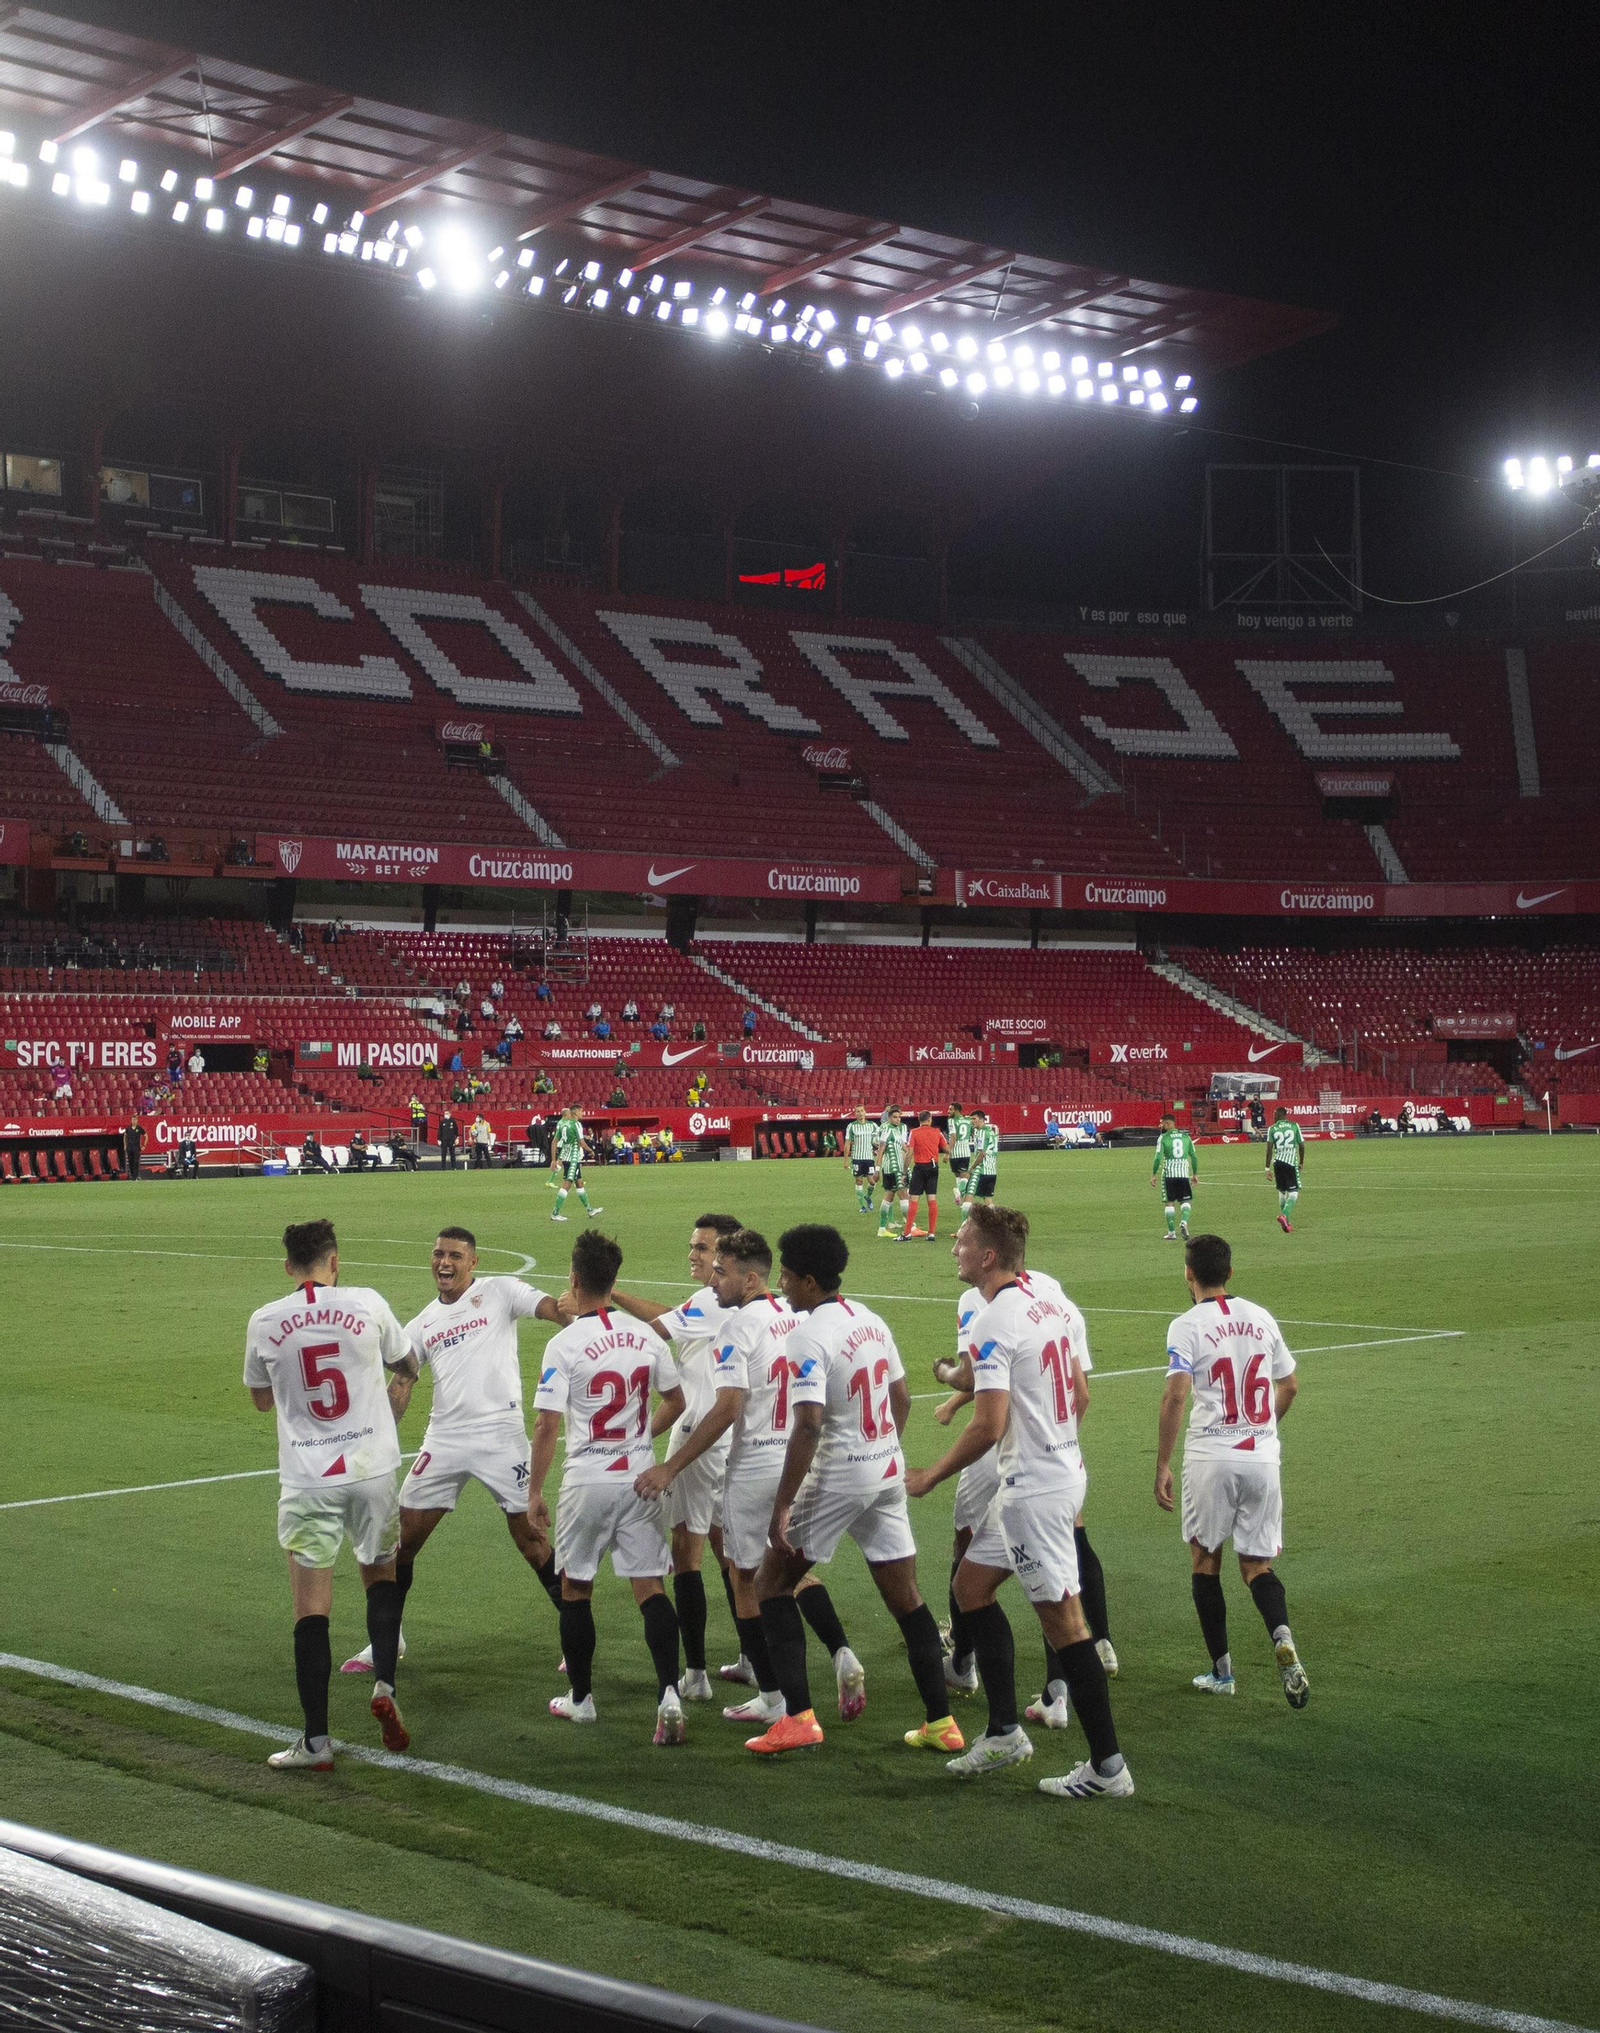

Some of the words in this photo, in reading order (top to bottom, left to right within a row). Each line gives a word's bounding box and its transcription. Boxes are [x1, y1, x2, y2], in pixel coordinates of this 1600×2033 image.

[1079, 606, 1087, 620] Y
[1091, 610, 1105, 621] es
[1109, 611, 1129, 624] por
[1137, 612, 1159, 623] eso
[1163, 613, 1187, 626] que
[1238, 613, 1260, 629] hoy
[1265, 616, 1303, 629] vengo
[1308, 617, 1315, 627] a
[1320, 614, 1353, 627] verte
[336, 843, 439, 863] MARATHON
[374, 864, 401, 875] BET
[469, 853, 573, 884] Cruzcampo
[768, 868, 860, 897] Cruzcampo
[986, 881, 1050, 900] CaixaBank
[1085, 882, 1167, 908] Cruzcampo
[1281, 889, 1374, 912] Cruzcampo
[171, 1015, 216, 1028] MOBILE
[219, 1016, 241, 1028] APP
[1016, 1020, 1046, 1029] SOCIO!
[17, 1041, 60, 1066] SFC
[101, 1042, 157, 1066] ERES
[337, 1043, 361, 1065] MI
[368, 1042, 438, 1066] PASION
[551, 1049, 623, 1058] MARATHONBET
[930, 1050, 976, 1060] CaixaBank
[1129, 1044, 1168, 1059] everfx
[708, 1116, 731, 1131] LaLi
[1044, 1107, 1112, 1126] Cruzcampo
[28, 1128, 64, 1137] Cruzcampo
[155, 1120, 257, 1145] Cruzcampo
[959, 1124, 968, 1140] 9
[1273, 1129, 1296, 1150] 22
[1172, 1138, 1184, 1158] 8
[268, 1309, 366, 1347] L.OCAMPOS
[424, 1317, 488, 1349] MARATHON
[1204, 1321, 1265, 1349] J.NAVAS
[443, 1333, 466, 1348] BET
[584, 1332, 648, 1361] OLIVER.T
[298, 1342, 350, 1421] 5
[1207, 1353, 1271, 1427] 16
[586, 1365, 650, 1442] 21
[767, 1356, 789, 1431] 1
[847, 1358, 895, 1443] 12
